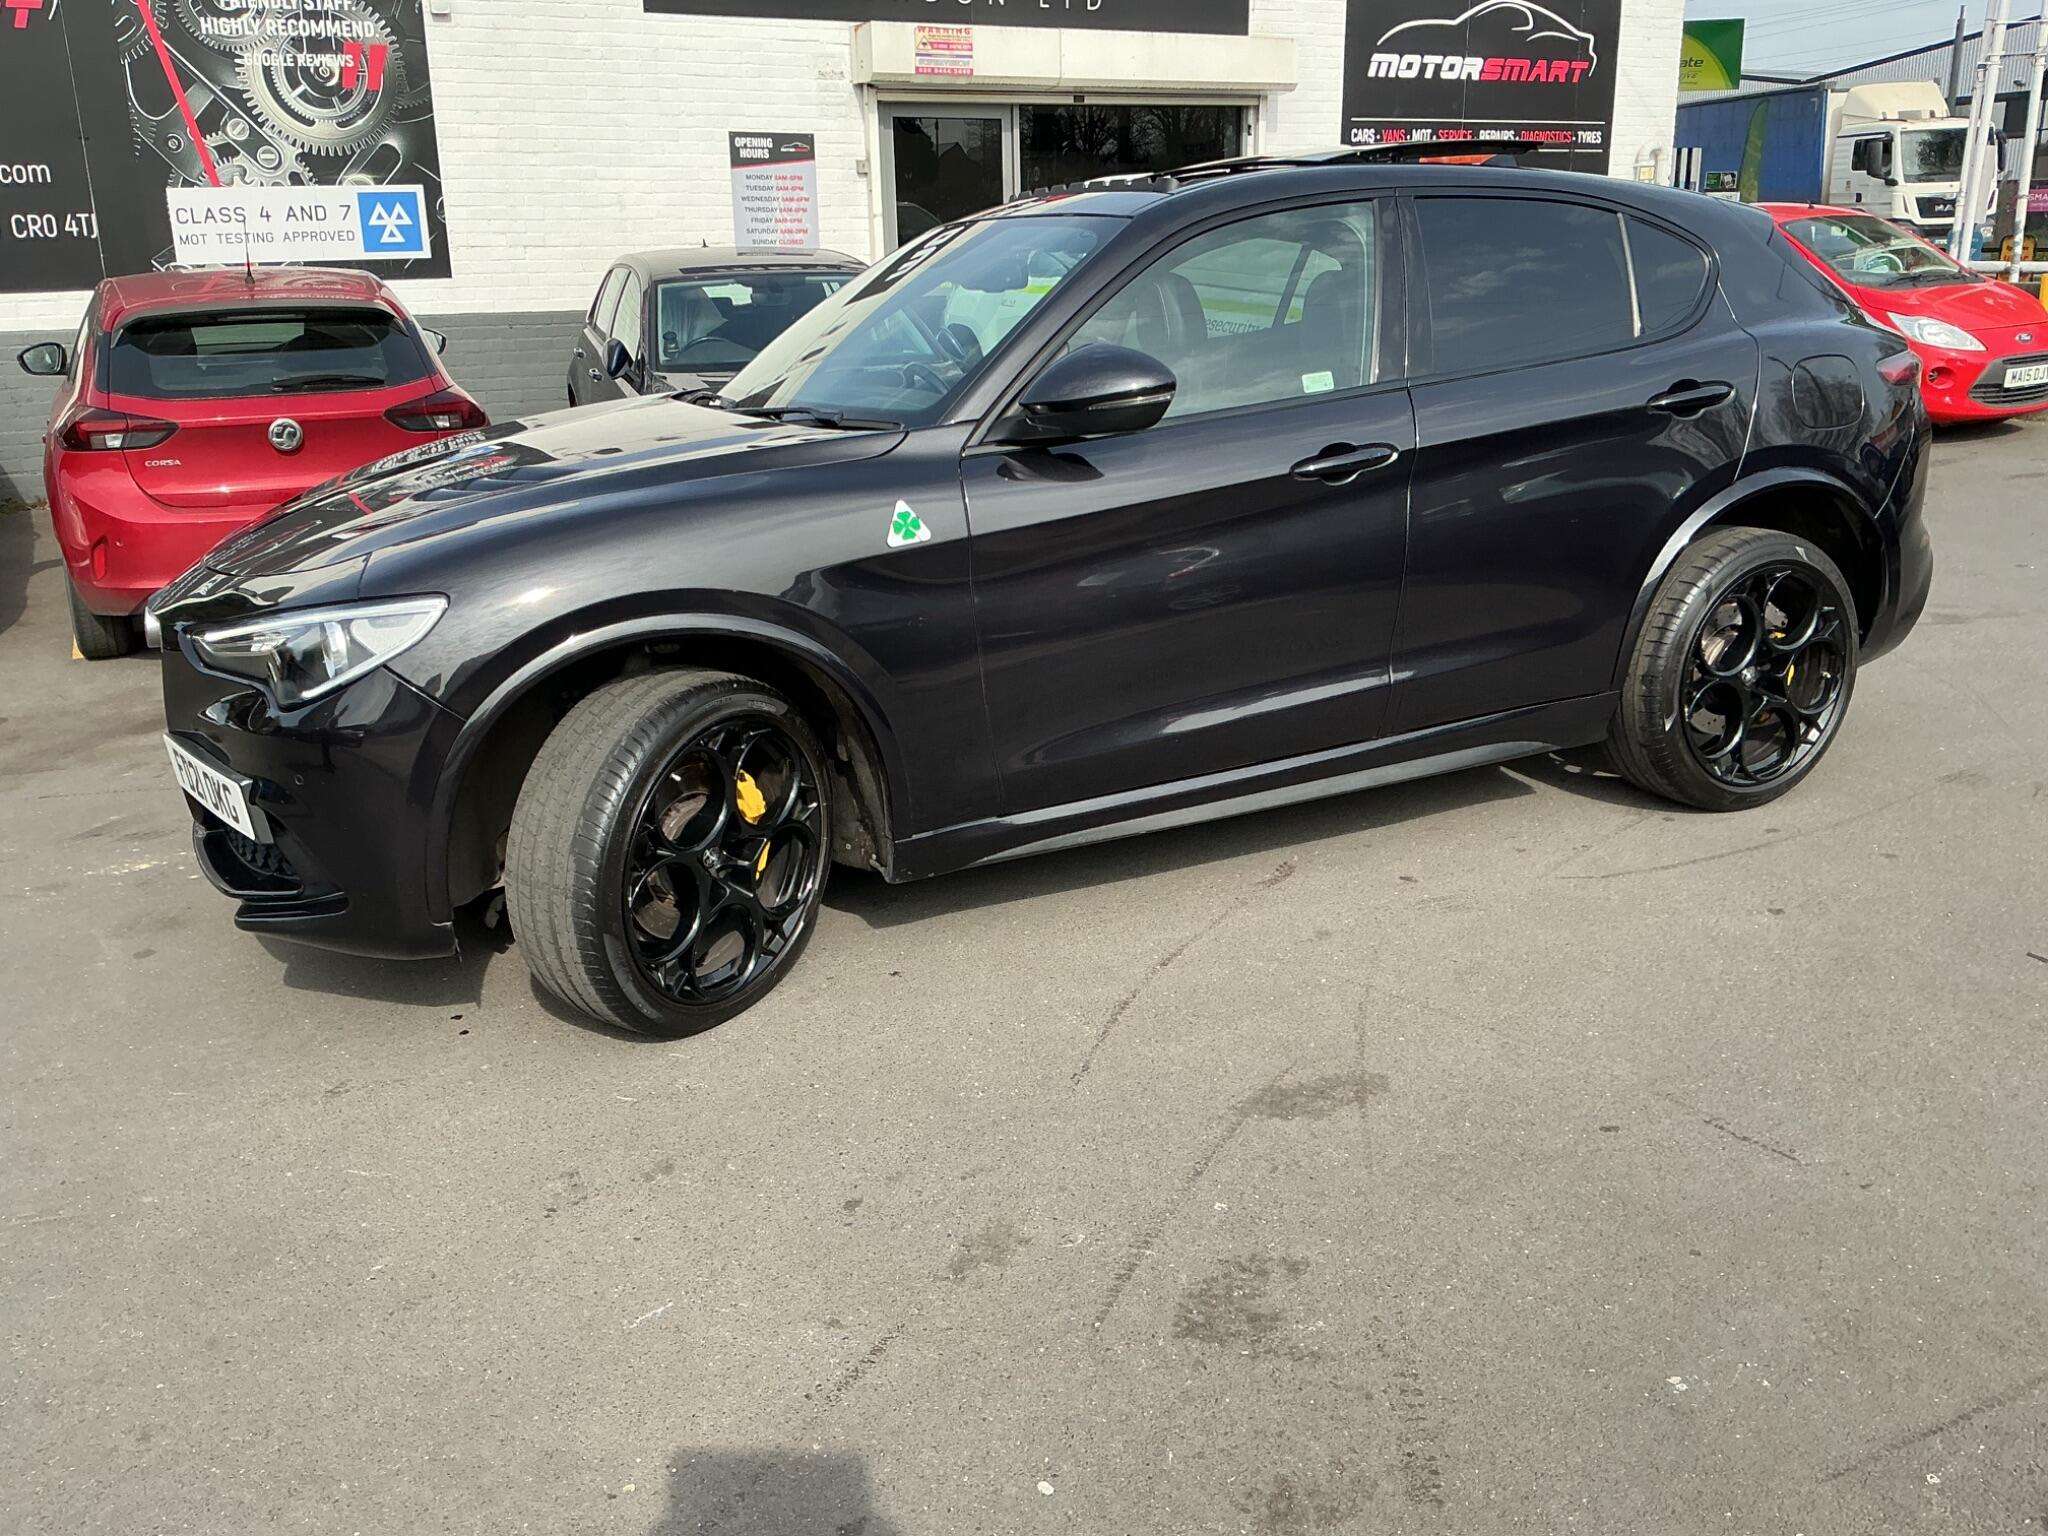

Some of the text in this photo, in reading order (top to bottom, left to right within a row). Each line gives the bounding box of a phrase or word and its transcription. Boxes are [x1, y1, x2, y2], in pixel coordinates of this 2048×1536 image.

[200, 17, 259, 35] HIGHLY
[246, 54, 354, 67] GOOGLE REVIEWS
[1367, 53, 1589, 83] MOTORSMART
[734, 137, 773, 148] OPENING
[1351, 128, 1602, 144] CARS VANS MOT SERVICE REPAIRS DIAGNOSTICS TYRES
[740, 148, 770, 159] HOURS
[176, 204, 351, 225] CLASS 4 AND 7
[1935, 204, 1955, 212] MA
[64, 213, 98, 239] 4TJ
[179, 230, 356, 246] MOT TESTING APPROVED
[144, 459, 182, 468] CORSA
